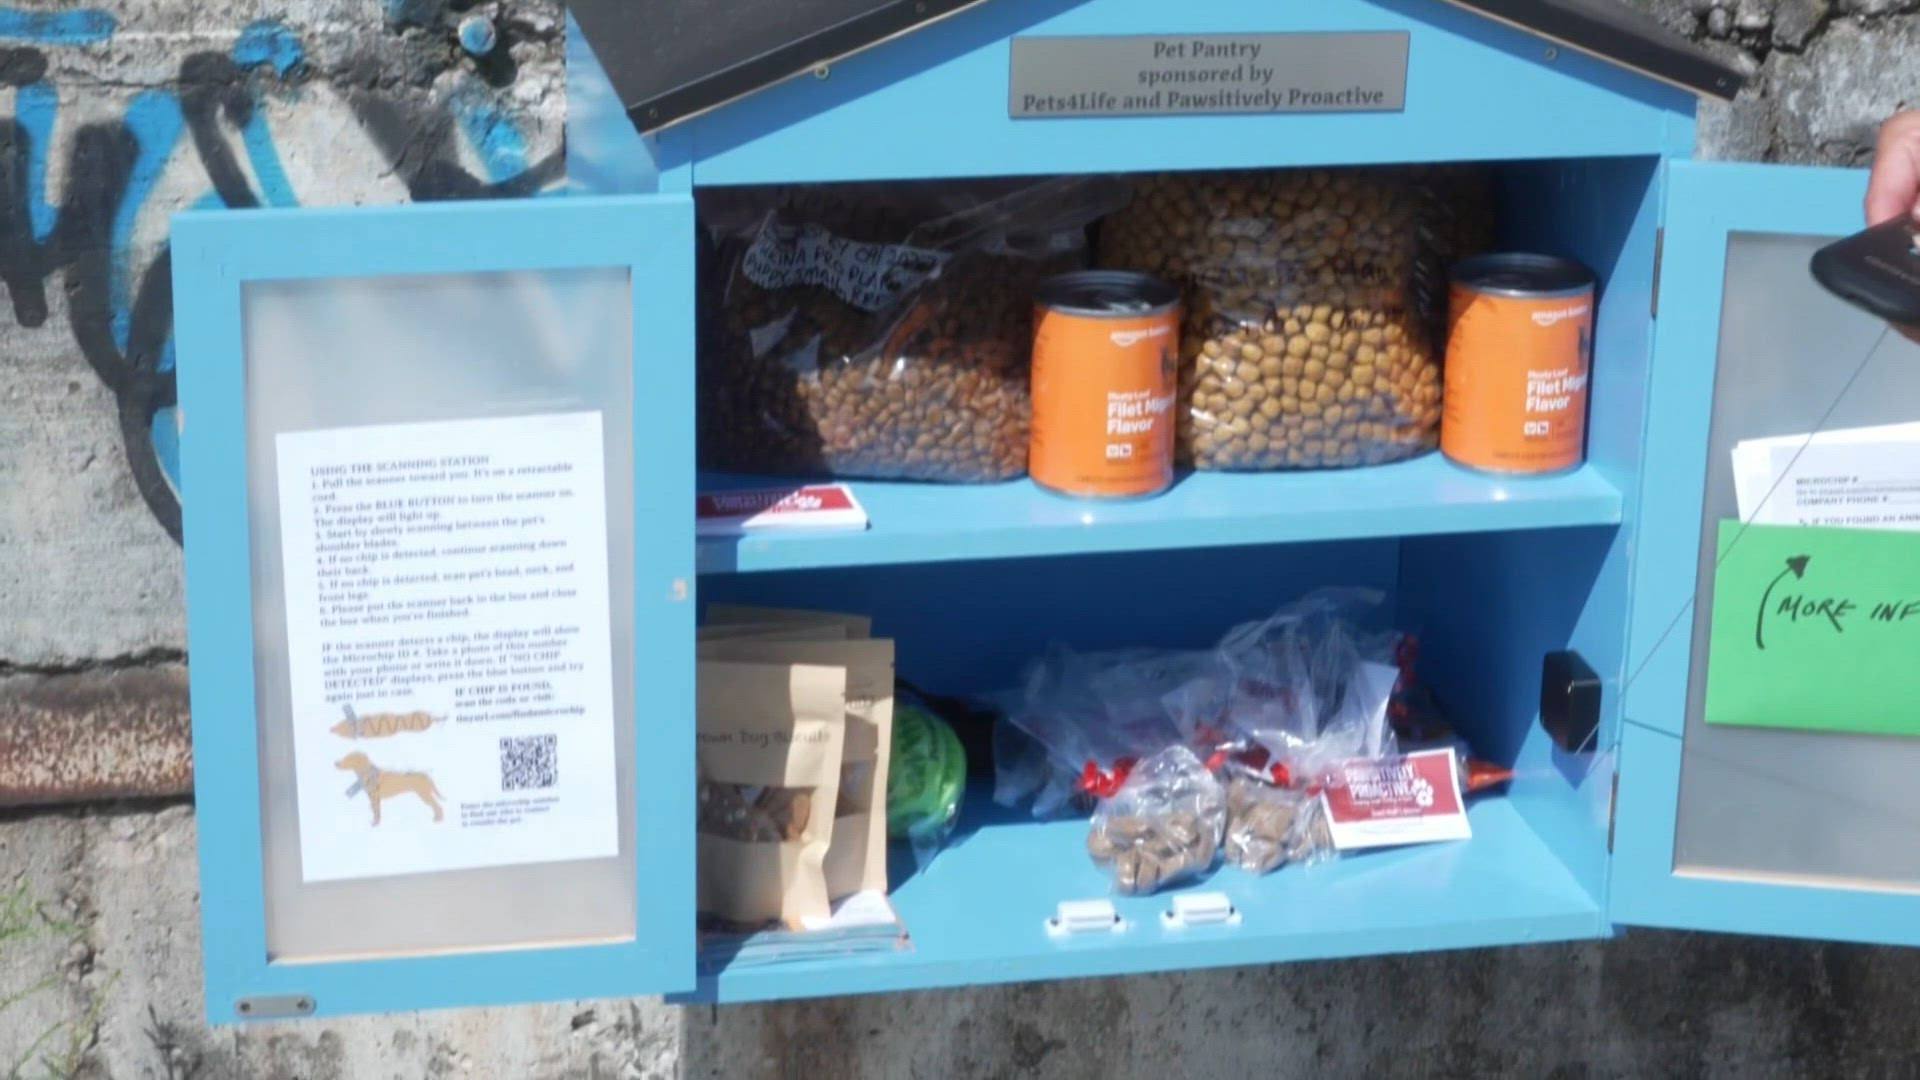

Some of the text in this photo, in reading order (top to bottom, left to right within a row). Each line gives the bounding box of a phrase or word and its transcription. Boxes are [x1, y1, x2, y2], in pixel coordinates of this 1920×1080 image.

[1153, 40, 1261, 60] Pet Pantry
[1138, 65, 1274, 87] sponsored by
[1023, 86, 1384, 112] Pets4Life and Pawsitively Proactive
[1527, 379, 1560, 396] Filet
[1108, 401, 1143, 418] Filet
[1526, 396, 1570, 413] Flavor
[1107, 418, 1154, 436] Flavor
[310, 454, 489, 477] USING THE SCANNING STATION
[322, 476, 342, 488] Pull
[346, 475, 361, 486] the
[365, 475, 405, 485] scanner
[409, 469, 445, 482] toward
[492, 468, 505, 476] on
[517, 461, 572, 474] retractable
[1796, 476, 1849, 486] MICROCHIP
[325, 501, 353, 512] Press
[355, 499, 372, 510] the
[375, 497, 403, 509] BLUE
[407, 494, 455, 507] BUTTON
[458, 493, 469, 503] to
[471, 491, 493, 502] turn
[497, 490, 513, 500] the
[516, 489, 555, 499] scanner
[1796, 496, 1843, 507] COMPANY
[1846, 494, 1879, 504] PHONE
[315, 509, 422, 527] The display will light
[327, 527, 351, 538] Start
[354, 525, 367, 538] by
[370, 523, 403, 537] slowly
[406, 520, 453, 535] scanning
[455, 516, 499, 529] between
[502, 515, 518, 526] the
[1824, 516, 1844, 525] YOU
[1846, 515, 1880, 524] FOUND
[315, 539, 359, 552] shoulder
[328, 553, 336, 563] If
[339, 554, 352, 562] no
[355, 550, 377, 563] chip
[380, 550, 389, 559] is
[441, 542, 486, 555] continue
[489, 539, 535, 554] scanning
[538, 537, 567, 548] down
[316, 566, 341, 577] their
[330, 578, 337, 588] If
[341, 579, 354, 587] no
[356, 575, 379, 588] chip
[382, 575, 390, 584] is
[442, 571, 465, 580] scan
[555, 561, 573, 572] and
[318, 590, 344, 601] front
[331, 586, 576, 613] Please put the scanner back in the box and close
[320, 616, 336, 627] the
[339, 614, 357, 625] box
[361, 612, 389, 624] when
[1776, 594, 1857, 633] MORE
[321, 641, 330, 651] IF
[335, 640, 351, 650] the
[354, 639, 394, 649] scanner
[397, 634, 435, 646] detects
[473, 630, 489, 640] the
[492, 627, 528, 641] display
[532, 625, 550, 636] will
[554, 623, 579, 634] show
[322, 653, 338, 664] the
[342, 649, 394, 664] Microchip
[397, 648, 409, 658] ID
[426, 645, 448, 656] Take
[460, 642, 490, 656] photo
[493, 641, 502, 651] of
[505, 639, 525, 650] this
[528, 636, 566, 649] number
[323, 665, 346, 676] with
[350, 665, 372, 676] your
[376, 660, 408, 674] phone
[424, 657, 450, 668] write
[454, 656, 461, 666] it
[498, 652, 506, 662] If
[533, 648, 560, 659] CHIP
[437, 671, 464, 682] press
[467, 667, 482, 678] the
[486, 665, 507, 676] blue
[511, 662, 544, 674] button
[547, 661, 566, 672] and
[568, 659, 584, 672] try
[325, 687, 388, 703] again just in
[455, 686, 463, 697] IF
[468, 684, 495, 696] CHIP
[498, 683, 508, 694] IS
[455, 699, 475, 708] scan
[478, 696, 492, 706] the
[518, 695, 528, 703] or
